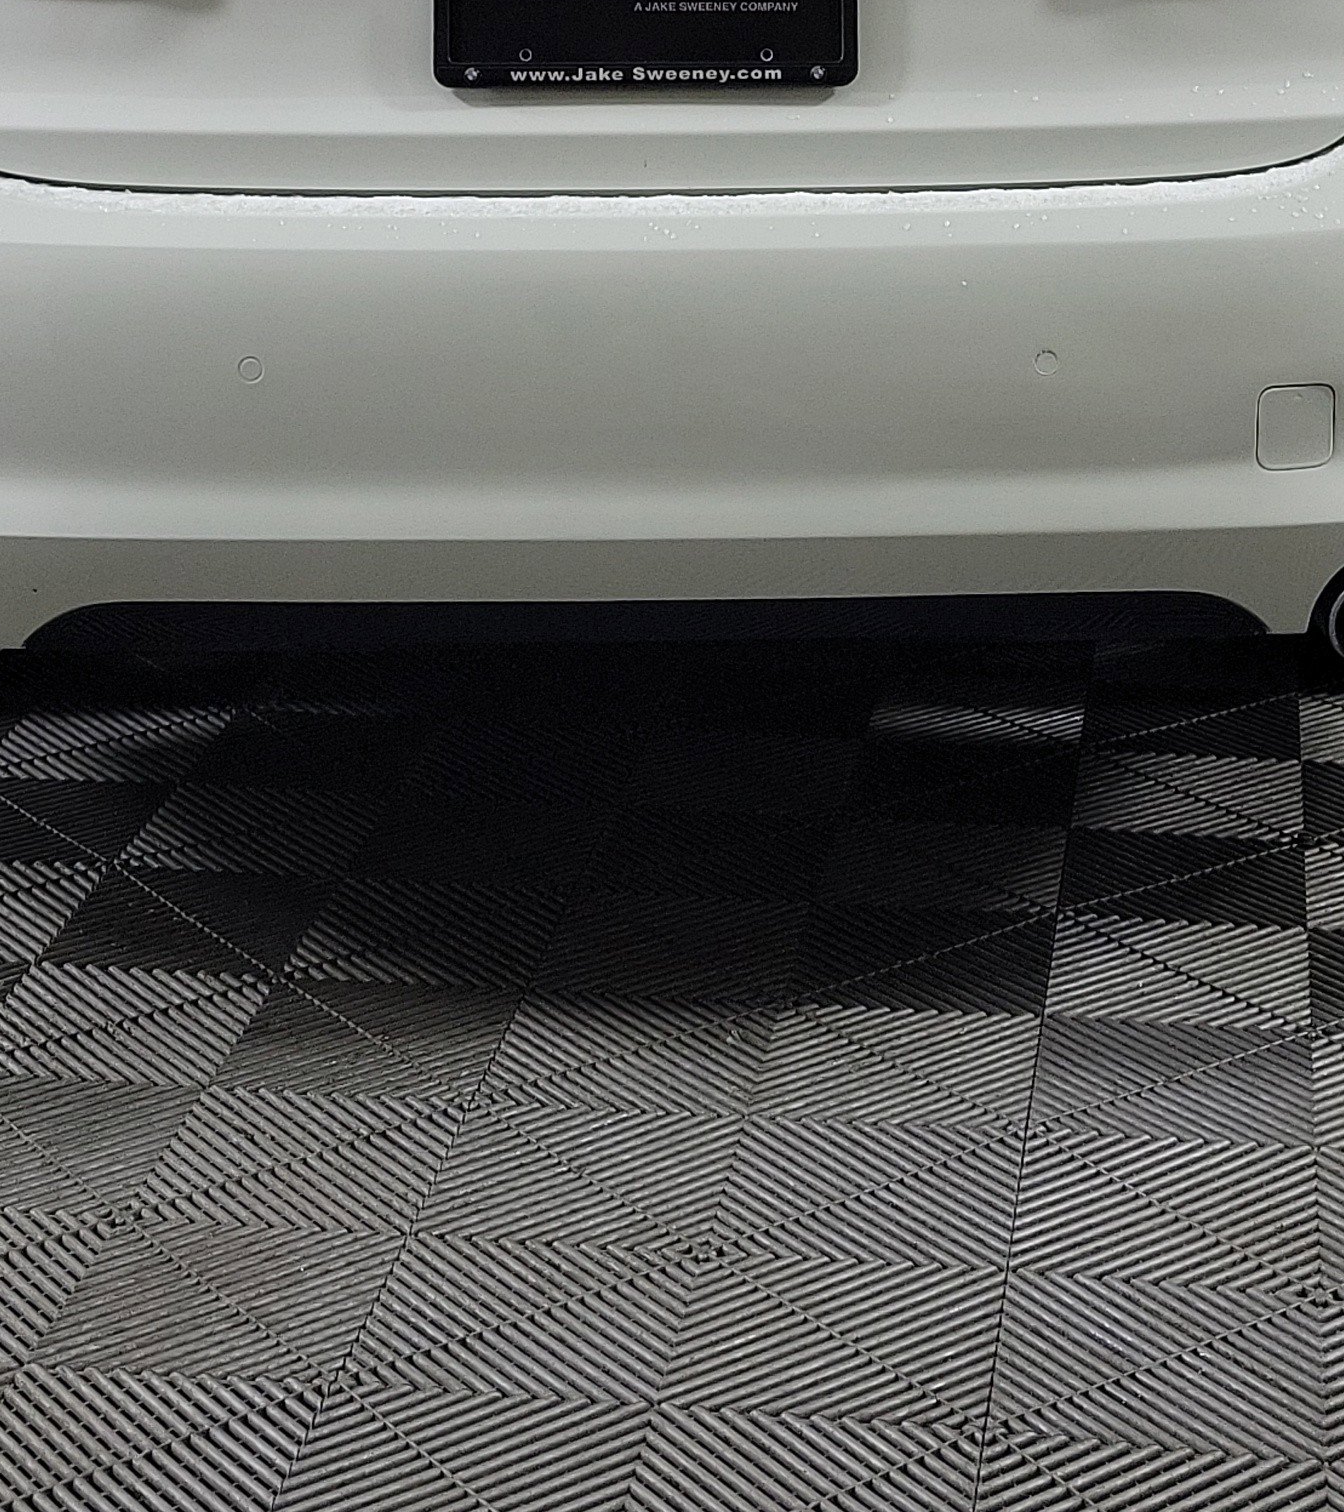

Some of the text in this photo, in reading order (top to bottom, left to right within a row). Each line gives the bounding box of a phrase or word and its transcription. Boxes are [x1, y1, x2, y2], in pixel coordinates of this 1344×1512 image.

[633, 2, 799, 12] A JAKE SWEENEY COMPANY
[510, 66, 783, 83] www.Jake Sweeney.com
